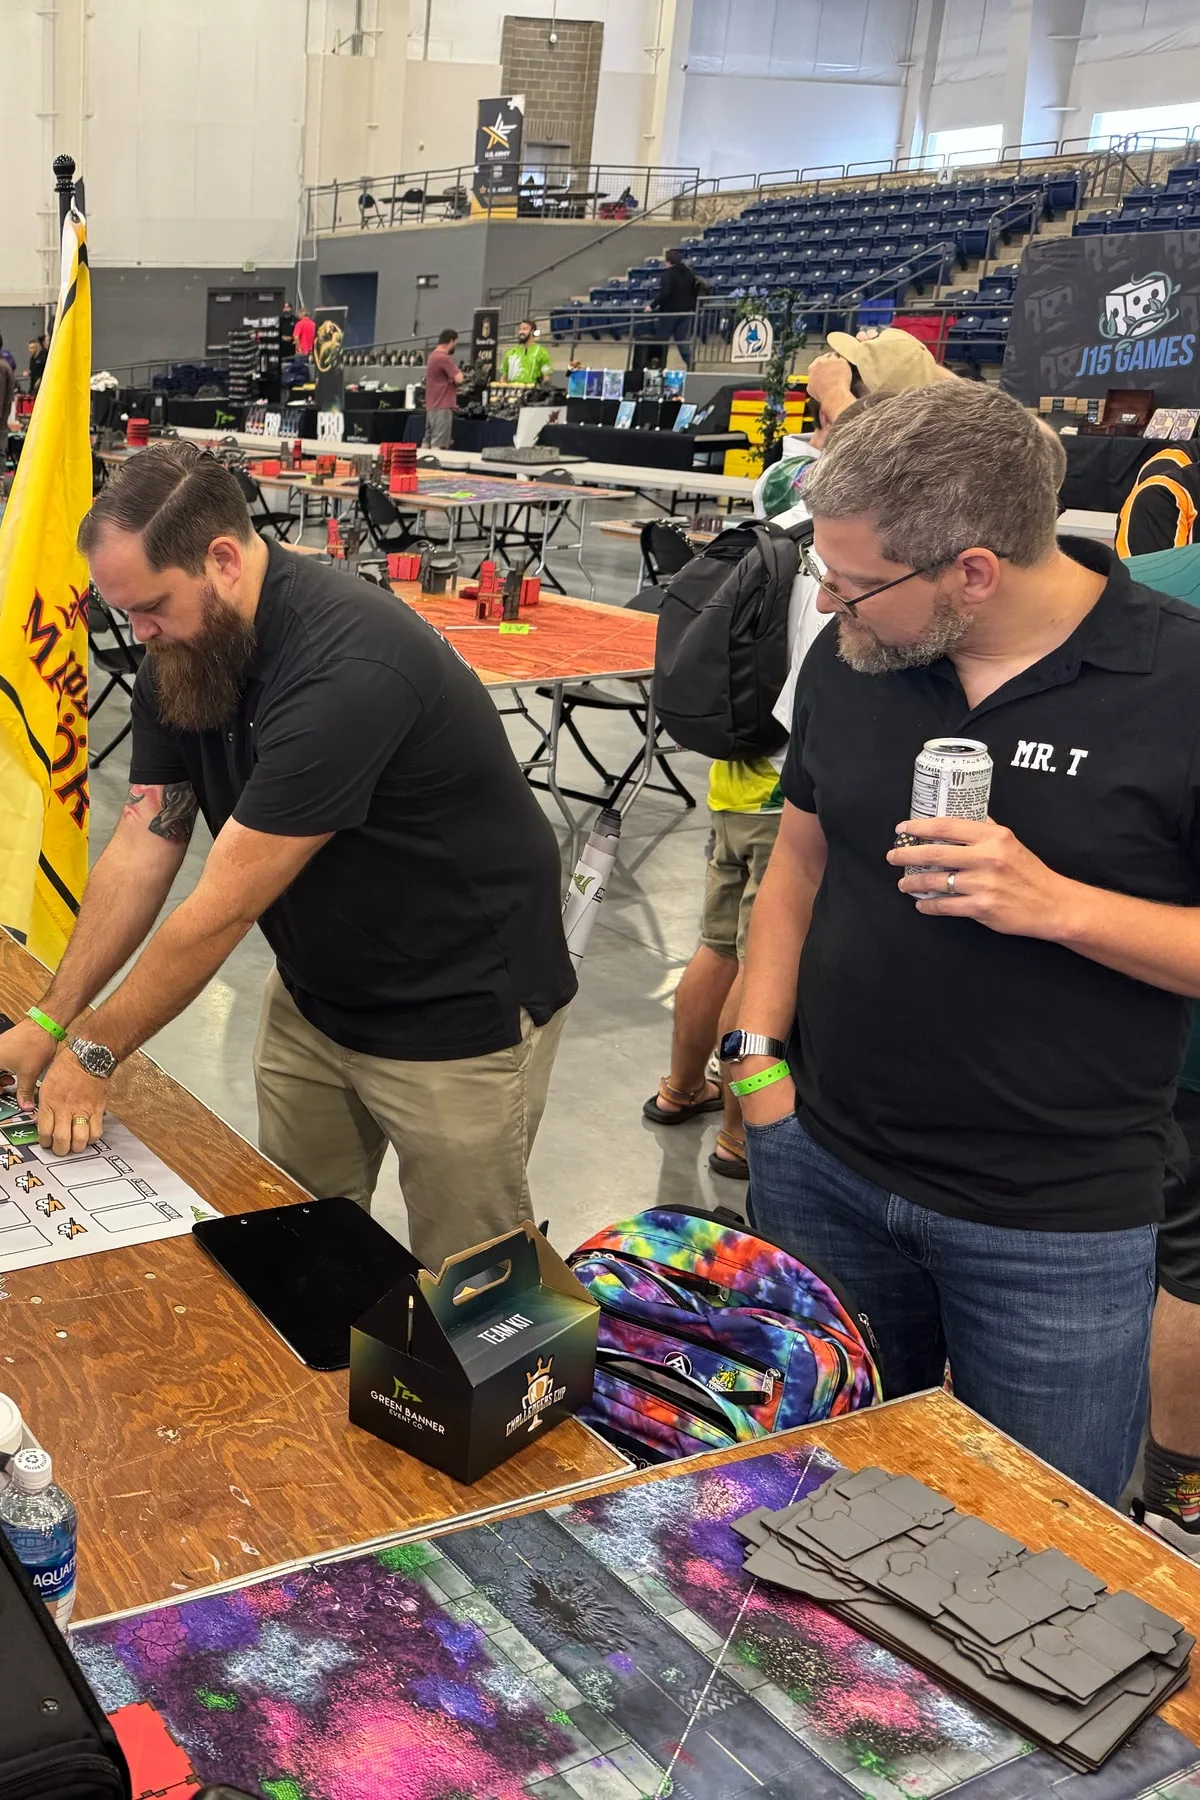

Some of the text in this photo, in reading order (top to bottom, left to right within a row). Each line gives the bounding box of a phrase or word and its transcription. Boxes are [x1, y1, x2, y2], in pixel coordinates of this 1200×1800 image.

[941, 169, 948, 180] A
[1076, 334, 1196, 377] J15 GAMES
[317, 411, 344, 436] PRO
[1010, 740, 1089, 777] MR. T
[477, 1313, 534, 1345] TEAM KIT
[370, 1390, 445, 1435] GREEN BANNER
[388, 1408, 425, 1431] EVENT CO.
[506, 1386, 567, 1437] CHALLENGERS CUP
